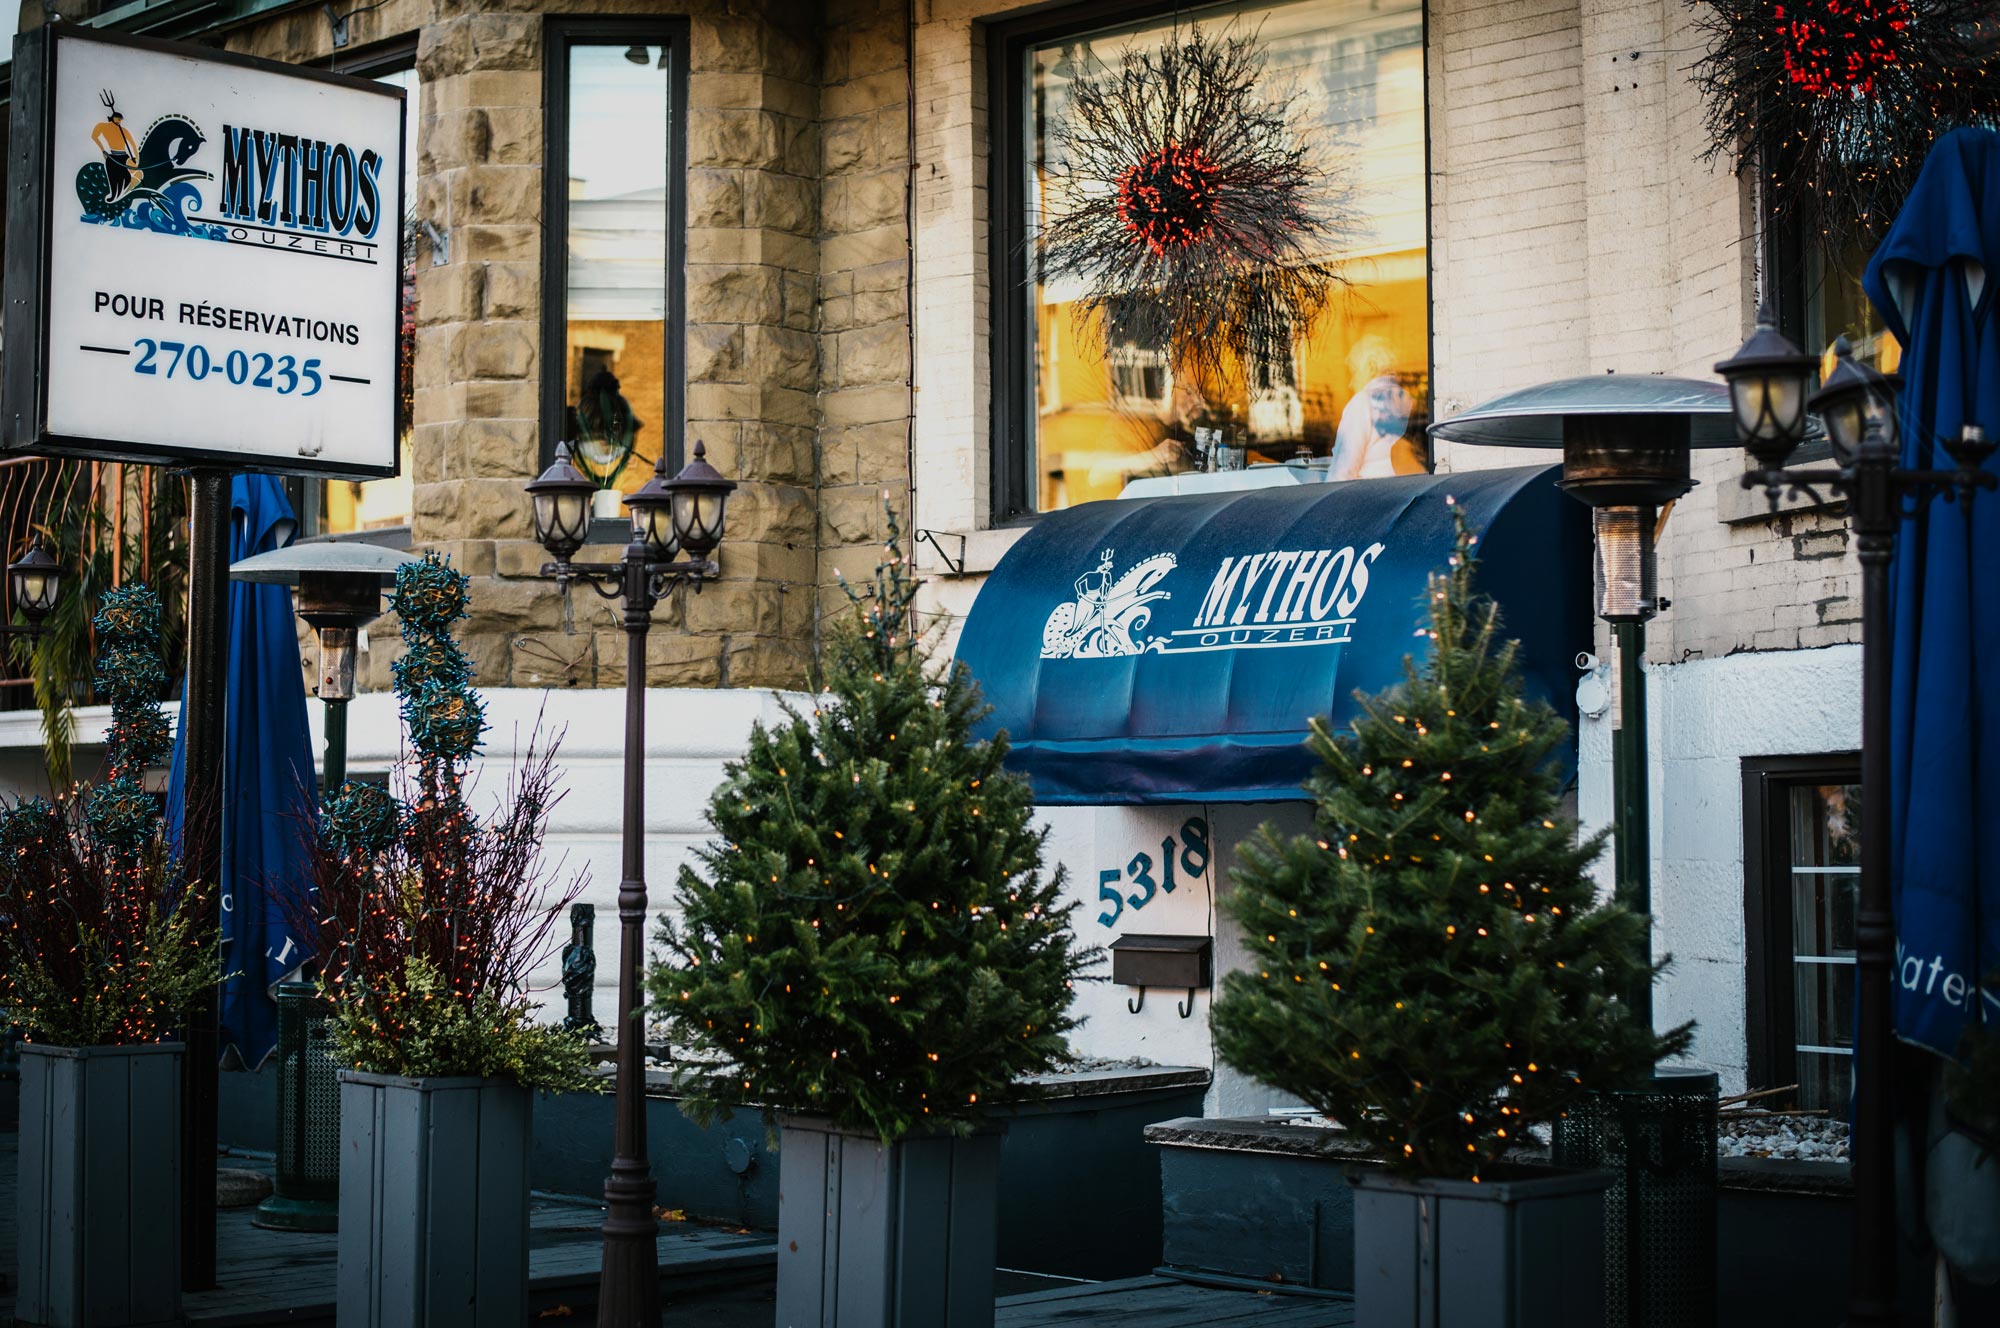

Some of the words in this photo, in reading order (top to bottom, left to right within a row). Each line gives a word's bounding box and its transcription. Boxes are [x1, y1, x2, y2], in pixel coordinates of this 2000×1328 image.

[219, 124, 383, 240] MYTHOS
[231, 228, 371, 259] OUZERI
[94, 291, 165, 321] POUR
[179, 300, 360, 346] RÉSERVATIONS
[133, 338, 322, 397] 270-0235
[1193, 542, 1385, 628] MYTHOS
[1200, 623, 1350, 647] OUZERI
[1097, 816, 1209, 928] 5318
